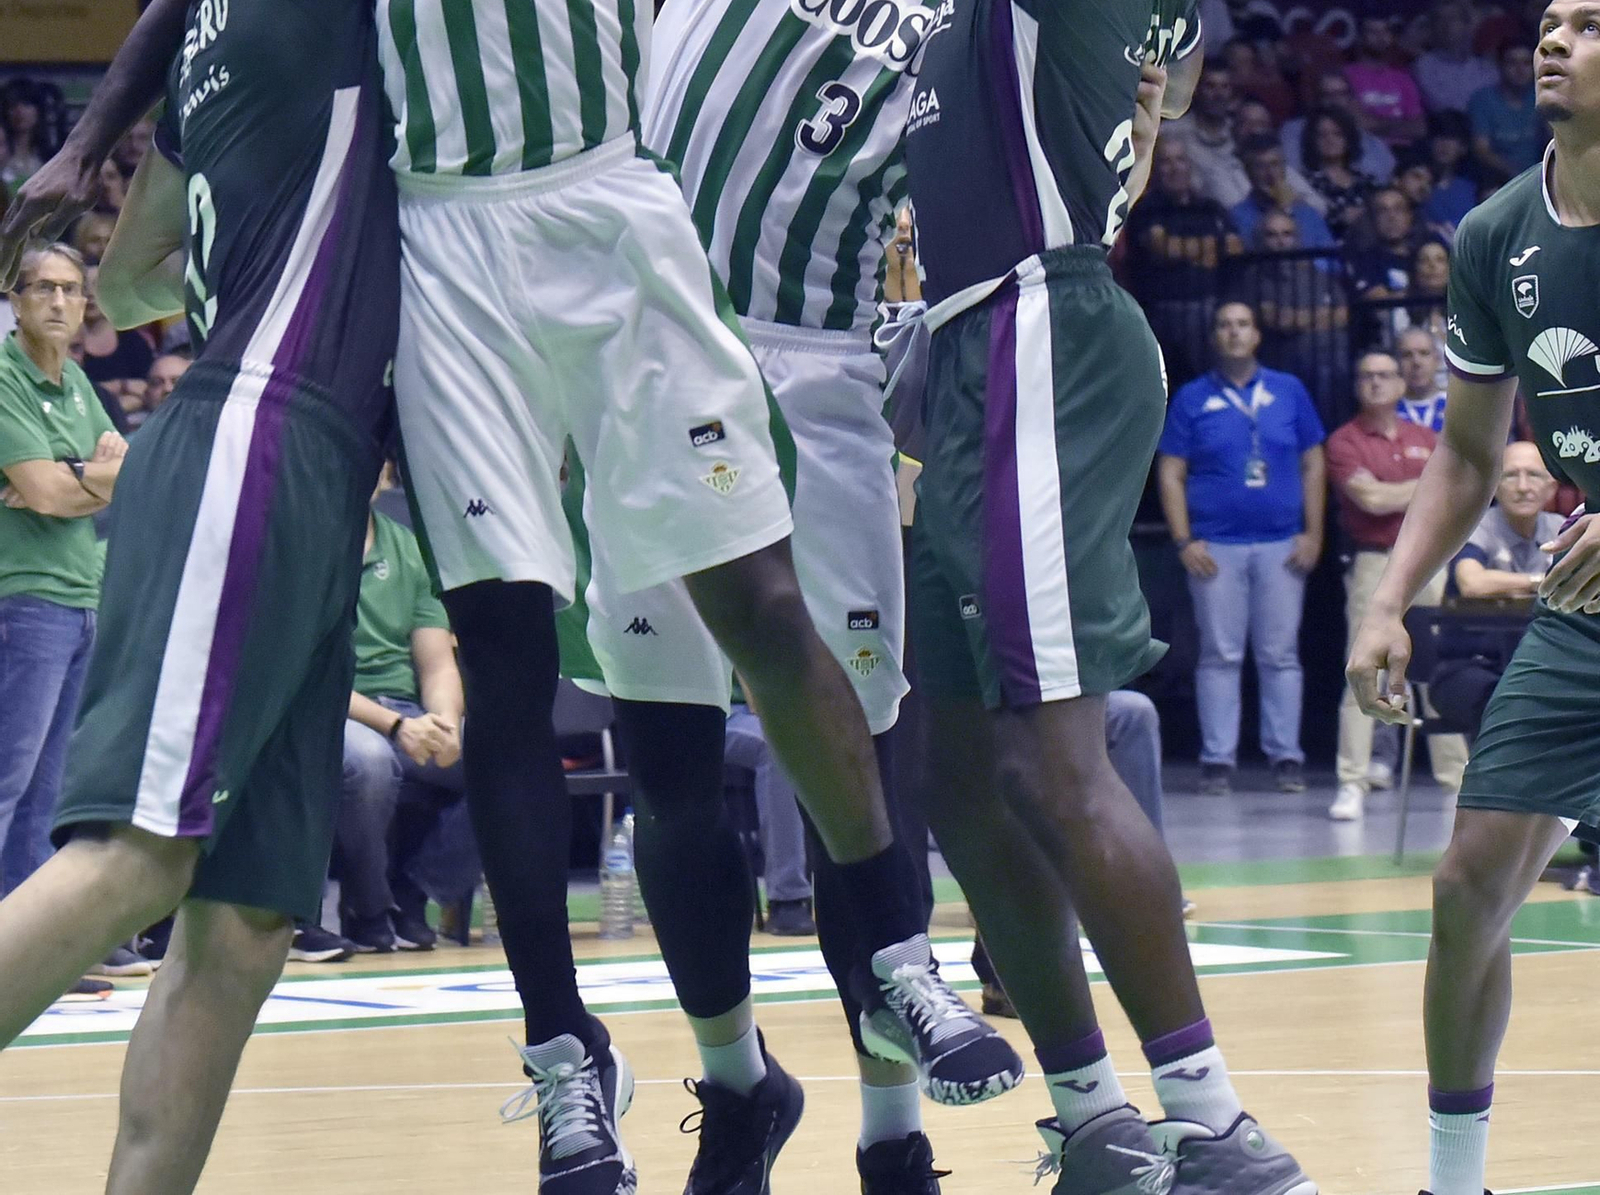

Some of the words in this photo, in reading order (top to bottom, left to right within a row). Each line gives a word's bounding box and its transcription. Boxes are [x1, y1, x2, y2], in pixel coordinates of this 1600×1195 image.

[795, 81, 862, 158] 3
[923, 112, 941, 127] SPORT
[693, 430, 718, 445] acb
[850, 618, 873, 629] acb
